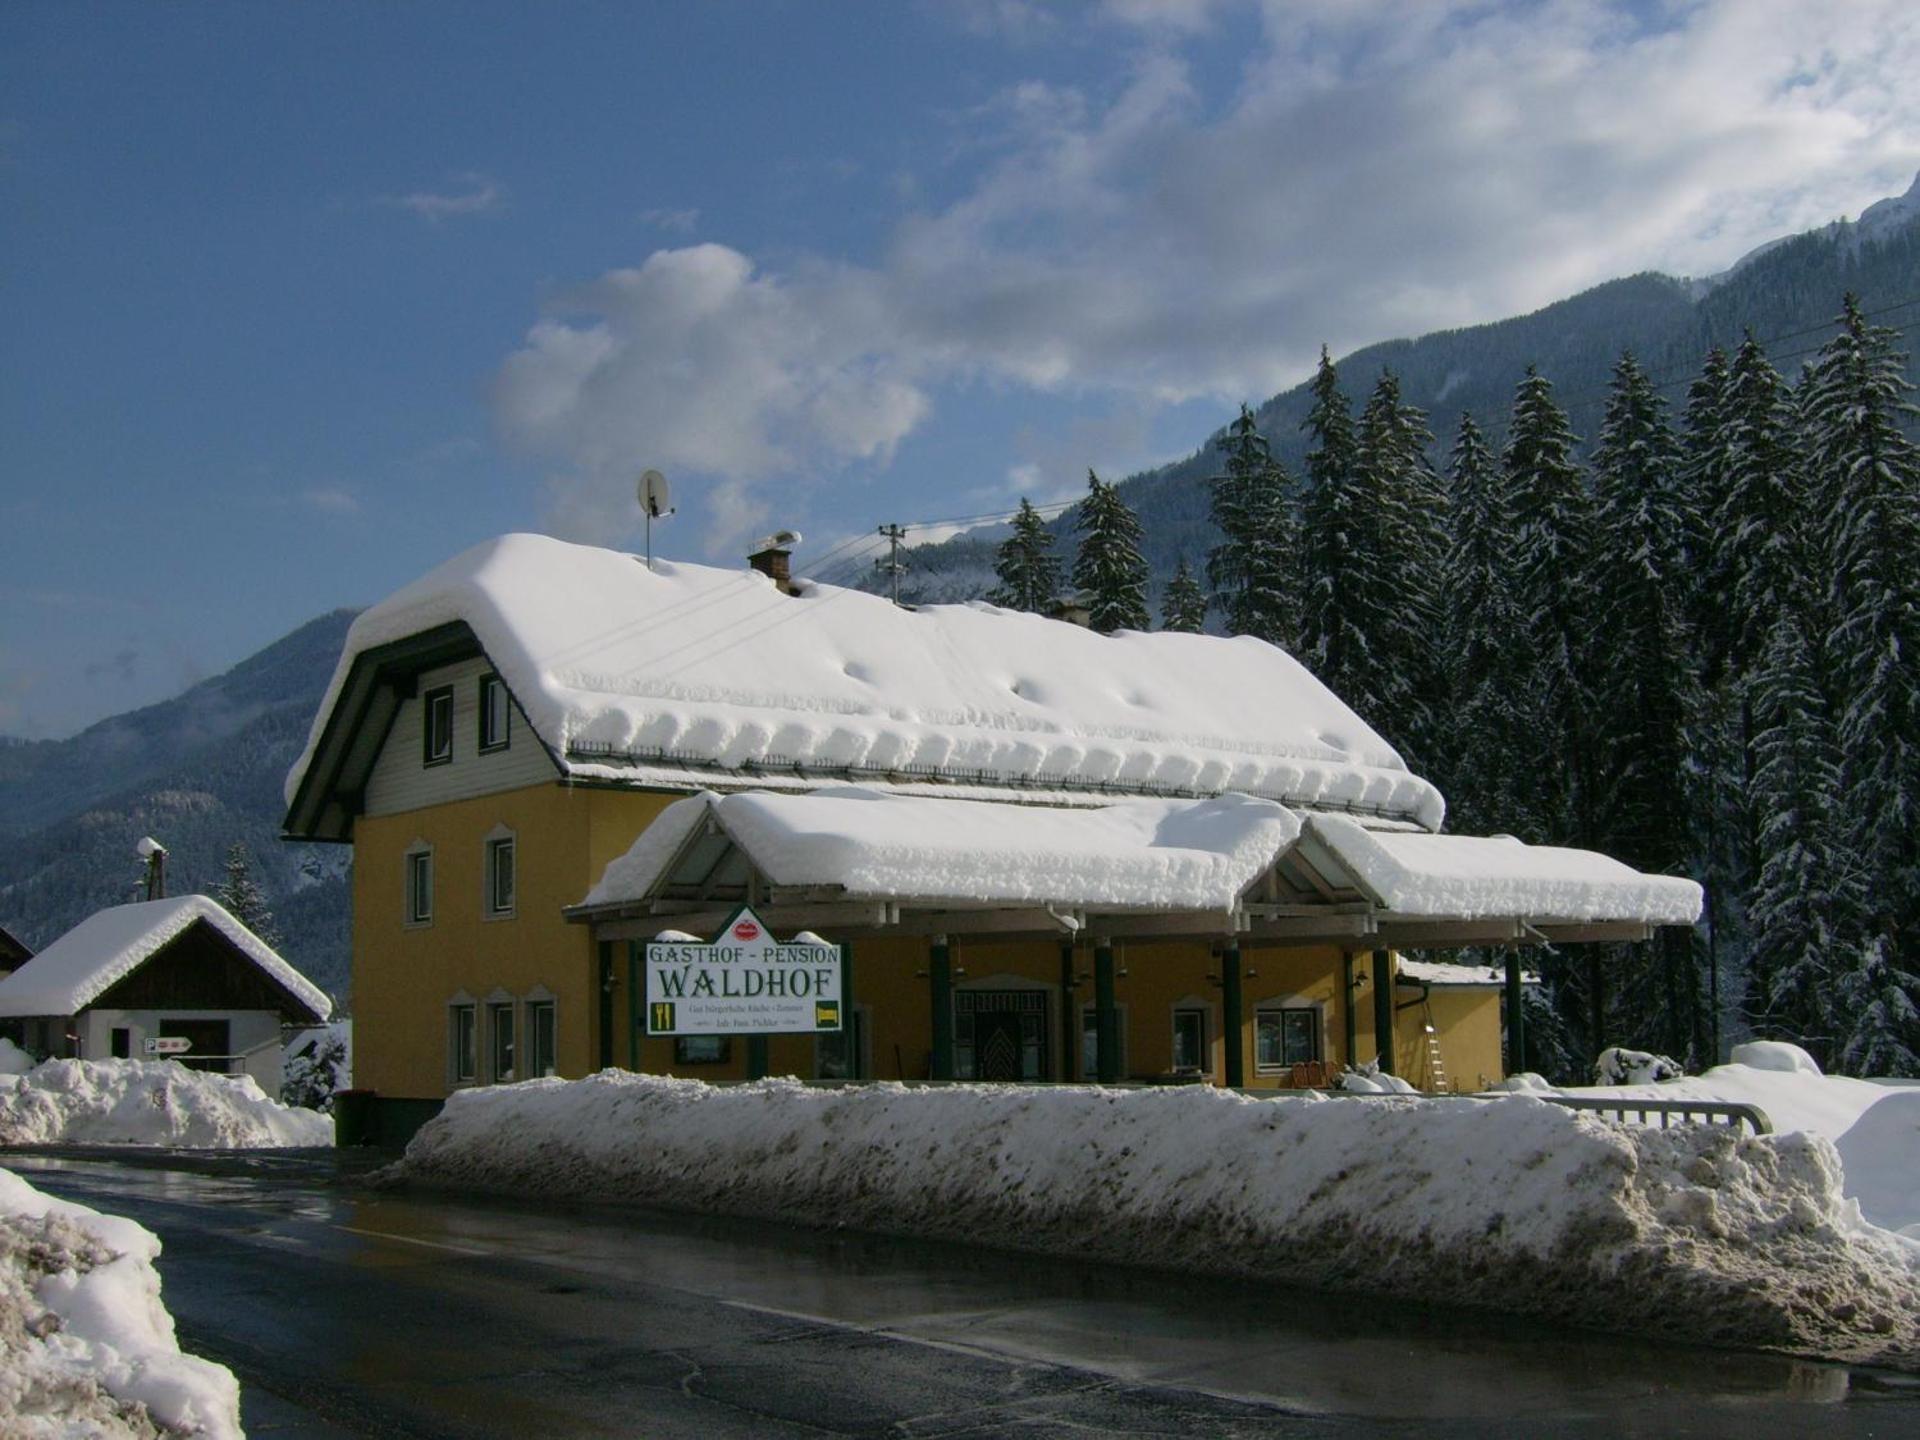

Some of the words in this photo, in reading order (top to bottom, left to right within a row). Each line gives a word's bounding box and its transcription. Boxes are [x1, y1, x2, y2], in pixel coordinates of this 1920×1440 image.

[649, 946, 744, 963] GASTHOF
[763, 946, 839, 963] PENSION
[658, 965, 833, 998] WALDHOF
